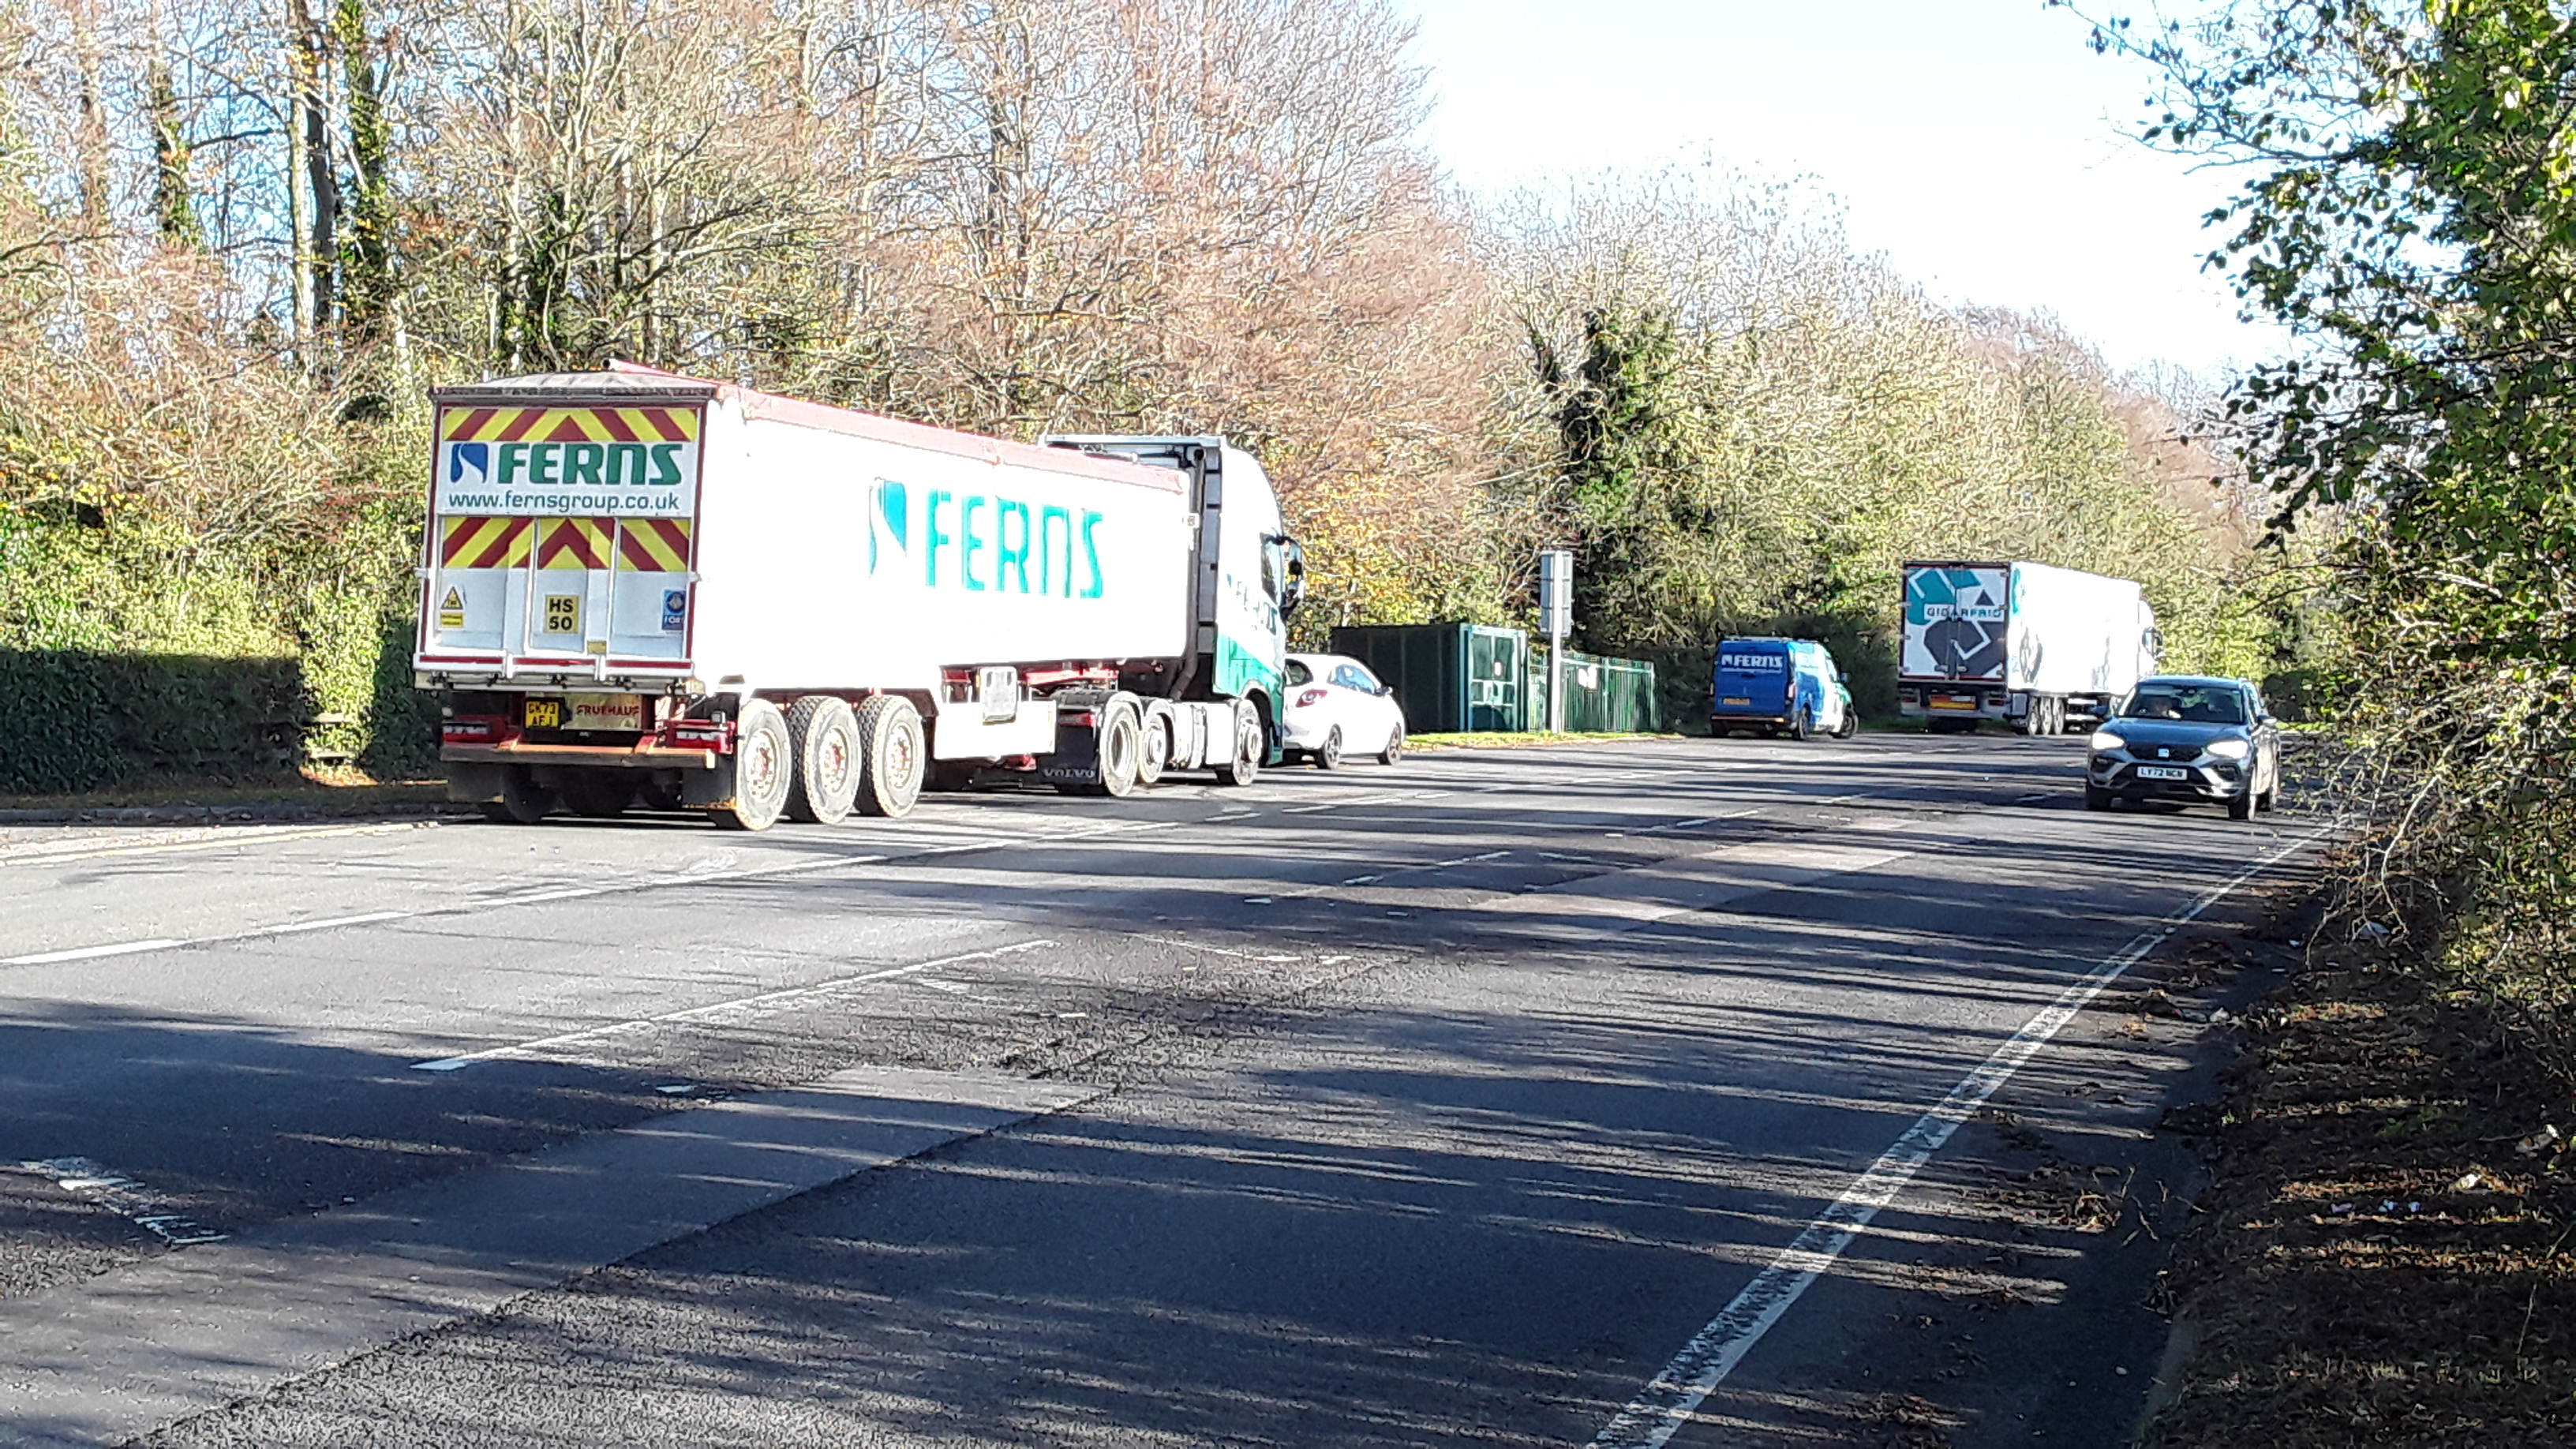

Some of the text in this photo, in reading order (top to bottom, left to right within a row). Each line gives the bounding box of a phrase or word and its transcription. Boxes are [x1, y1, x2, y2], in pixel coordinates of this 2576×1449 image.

[498, 443, 683, 485] FERNS
[449, 490, 680, 513] www.fernsgroup.co.uk
[925, 489, 1103, 598] FERNS
[549, 597, 574, 613] HS
[549, 616, 573, 631] 50
[1733, 654, 1783, 668] FERNS
[576, 705, 639, 716] FRUEHAUF
[1043, 769, 1095, 778] VOLVO
